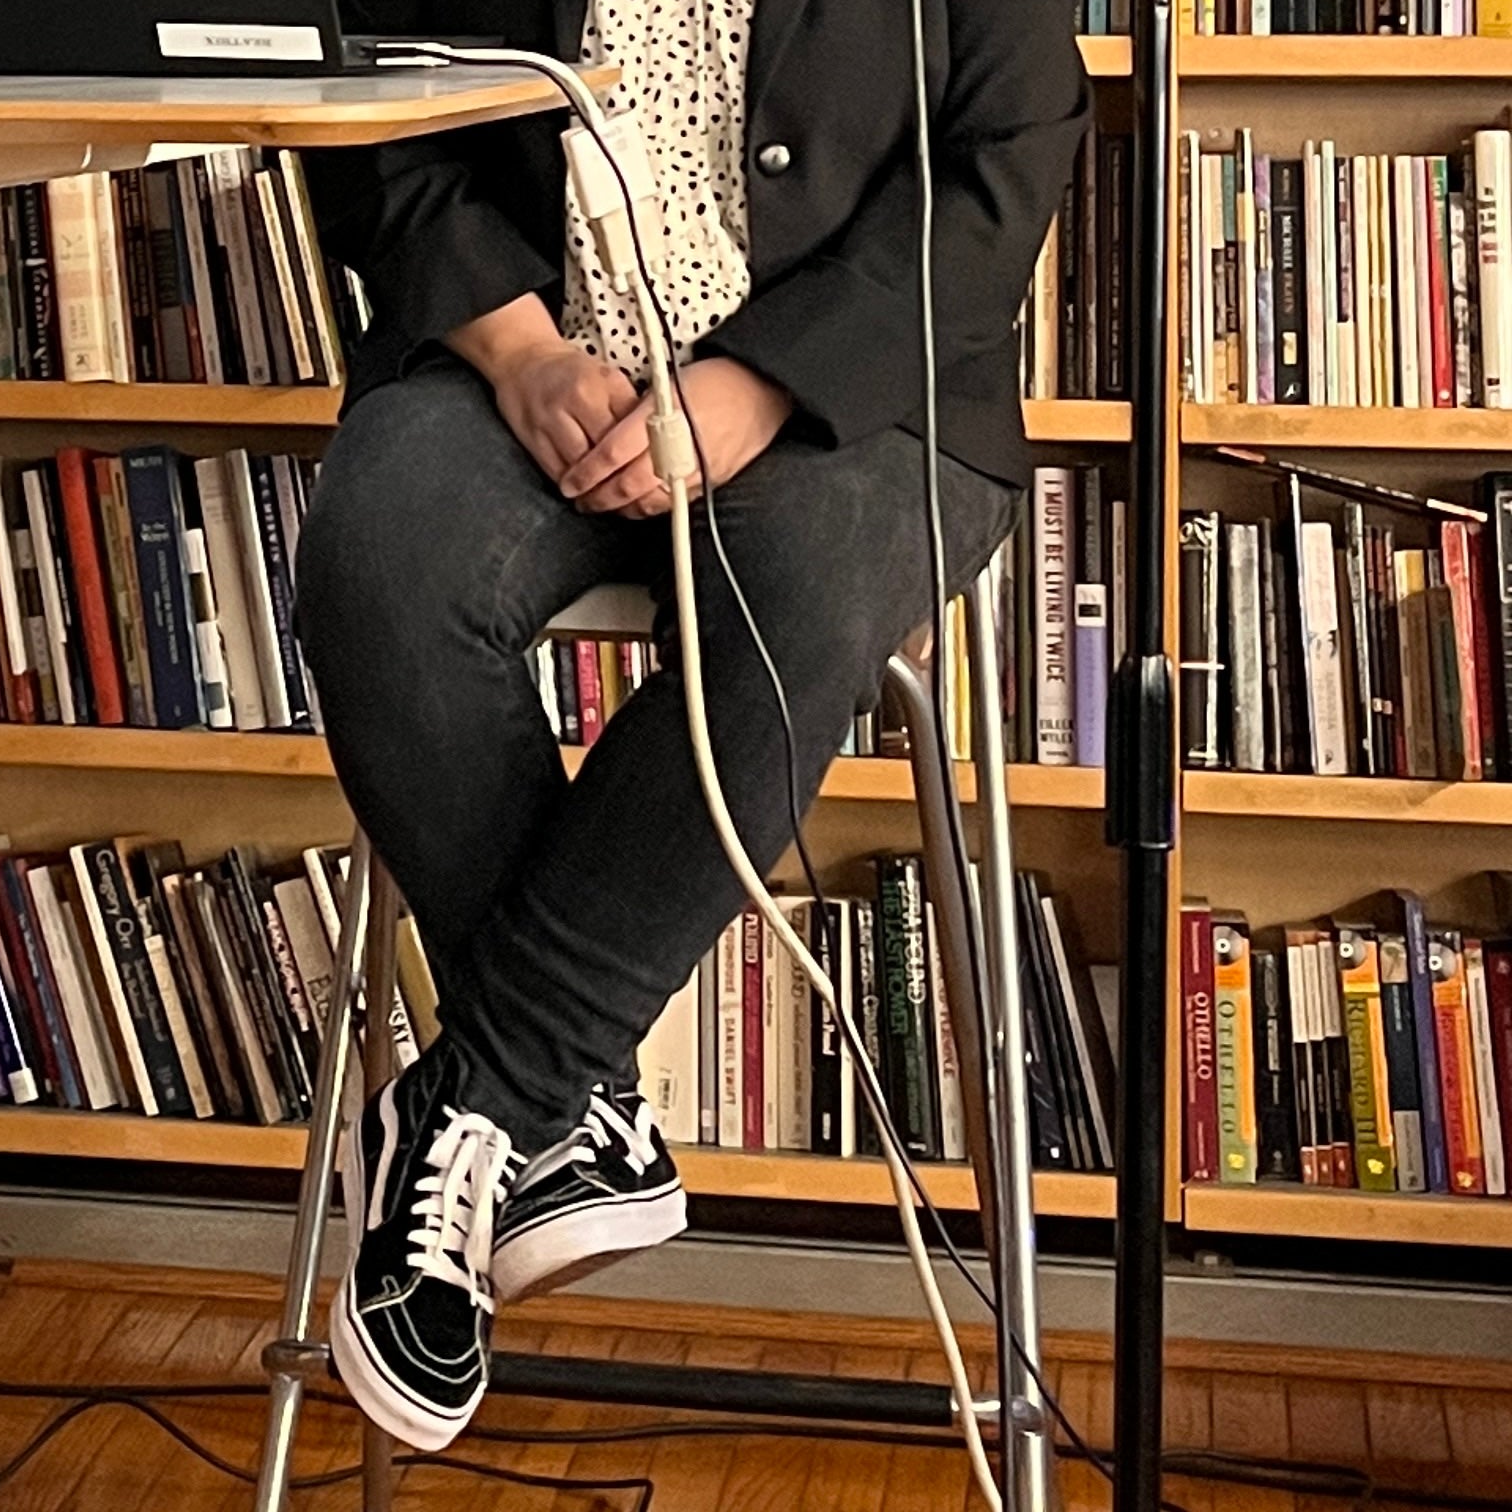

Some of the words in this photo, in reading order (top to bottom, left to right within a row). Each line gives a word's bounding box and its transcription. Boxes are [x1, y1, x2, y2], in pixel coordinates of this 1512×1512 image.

[1282, 214, 1293, 269] MICHAEL
[263, 502, 281, 564] MERWIN
[1045, 491, 1065, 536] MUST
[1045, 543, 1065, 563] BE
[1045, 570, 1065, 623] LIVING
[1046, 631, 1066, 684] TWICE
[95, 848, 123, 921] Gregory
[115, 917, 135, 950] Orr
[881, 878, 904, 915] THE
[883, 917, 906, 966] LAST
[905, 931, 928, 1005] POUND
[889, 967, 909, 1034] ROWER
[1192, 991, 1213, 1080] OTHELLO
[1346, 998, 1369, 1107] RICHARD
[1217, 999, 1237, 1135] OTHELLO
[1356, 1116, 1377, 1145] III
